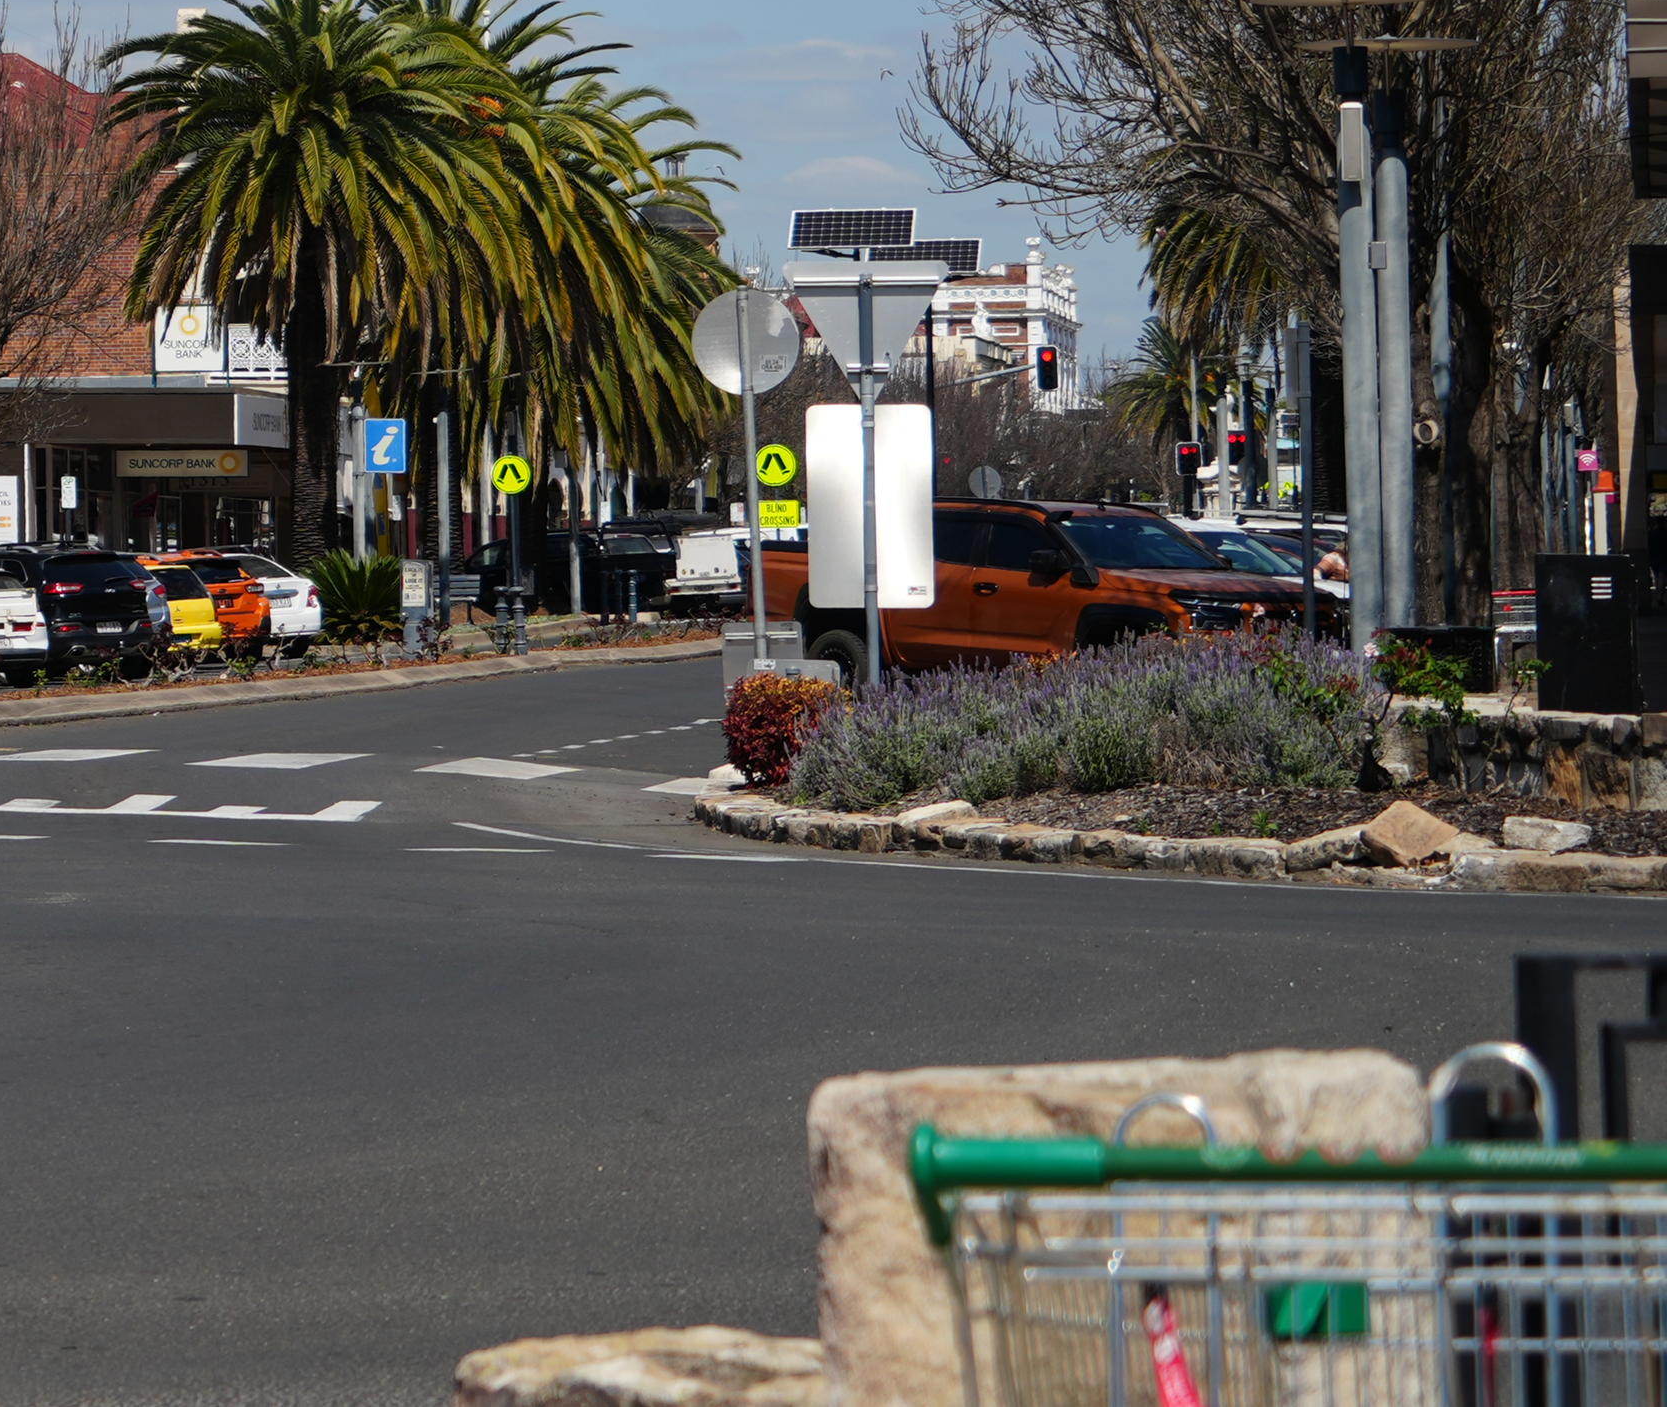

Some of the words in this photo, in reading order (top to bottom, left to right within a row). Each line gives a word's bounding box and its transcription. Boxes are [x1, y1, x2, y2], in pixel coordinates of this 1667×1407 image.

[175, 349, 203, 358] BANK
[129, 458, 184, 469] SUNCORP
[186, 458, 216, 469] BANK
[766, 504, 787, 513] BLIND
[759, 515, 796, 526] CROSSING
